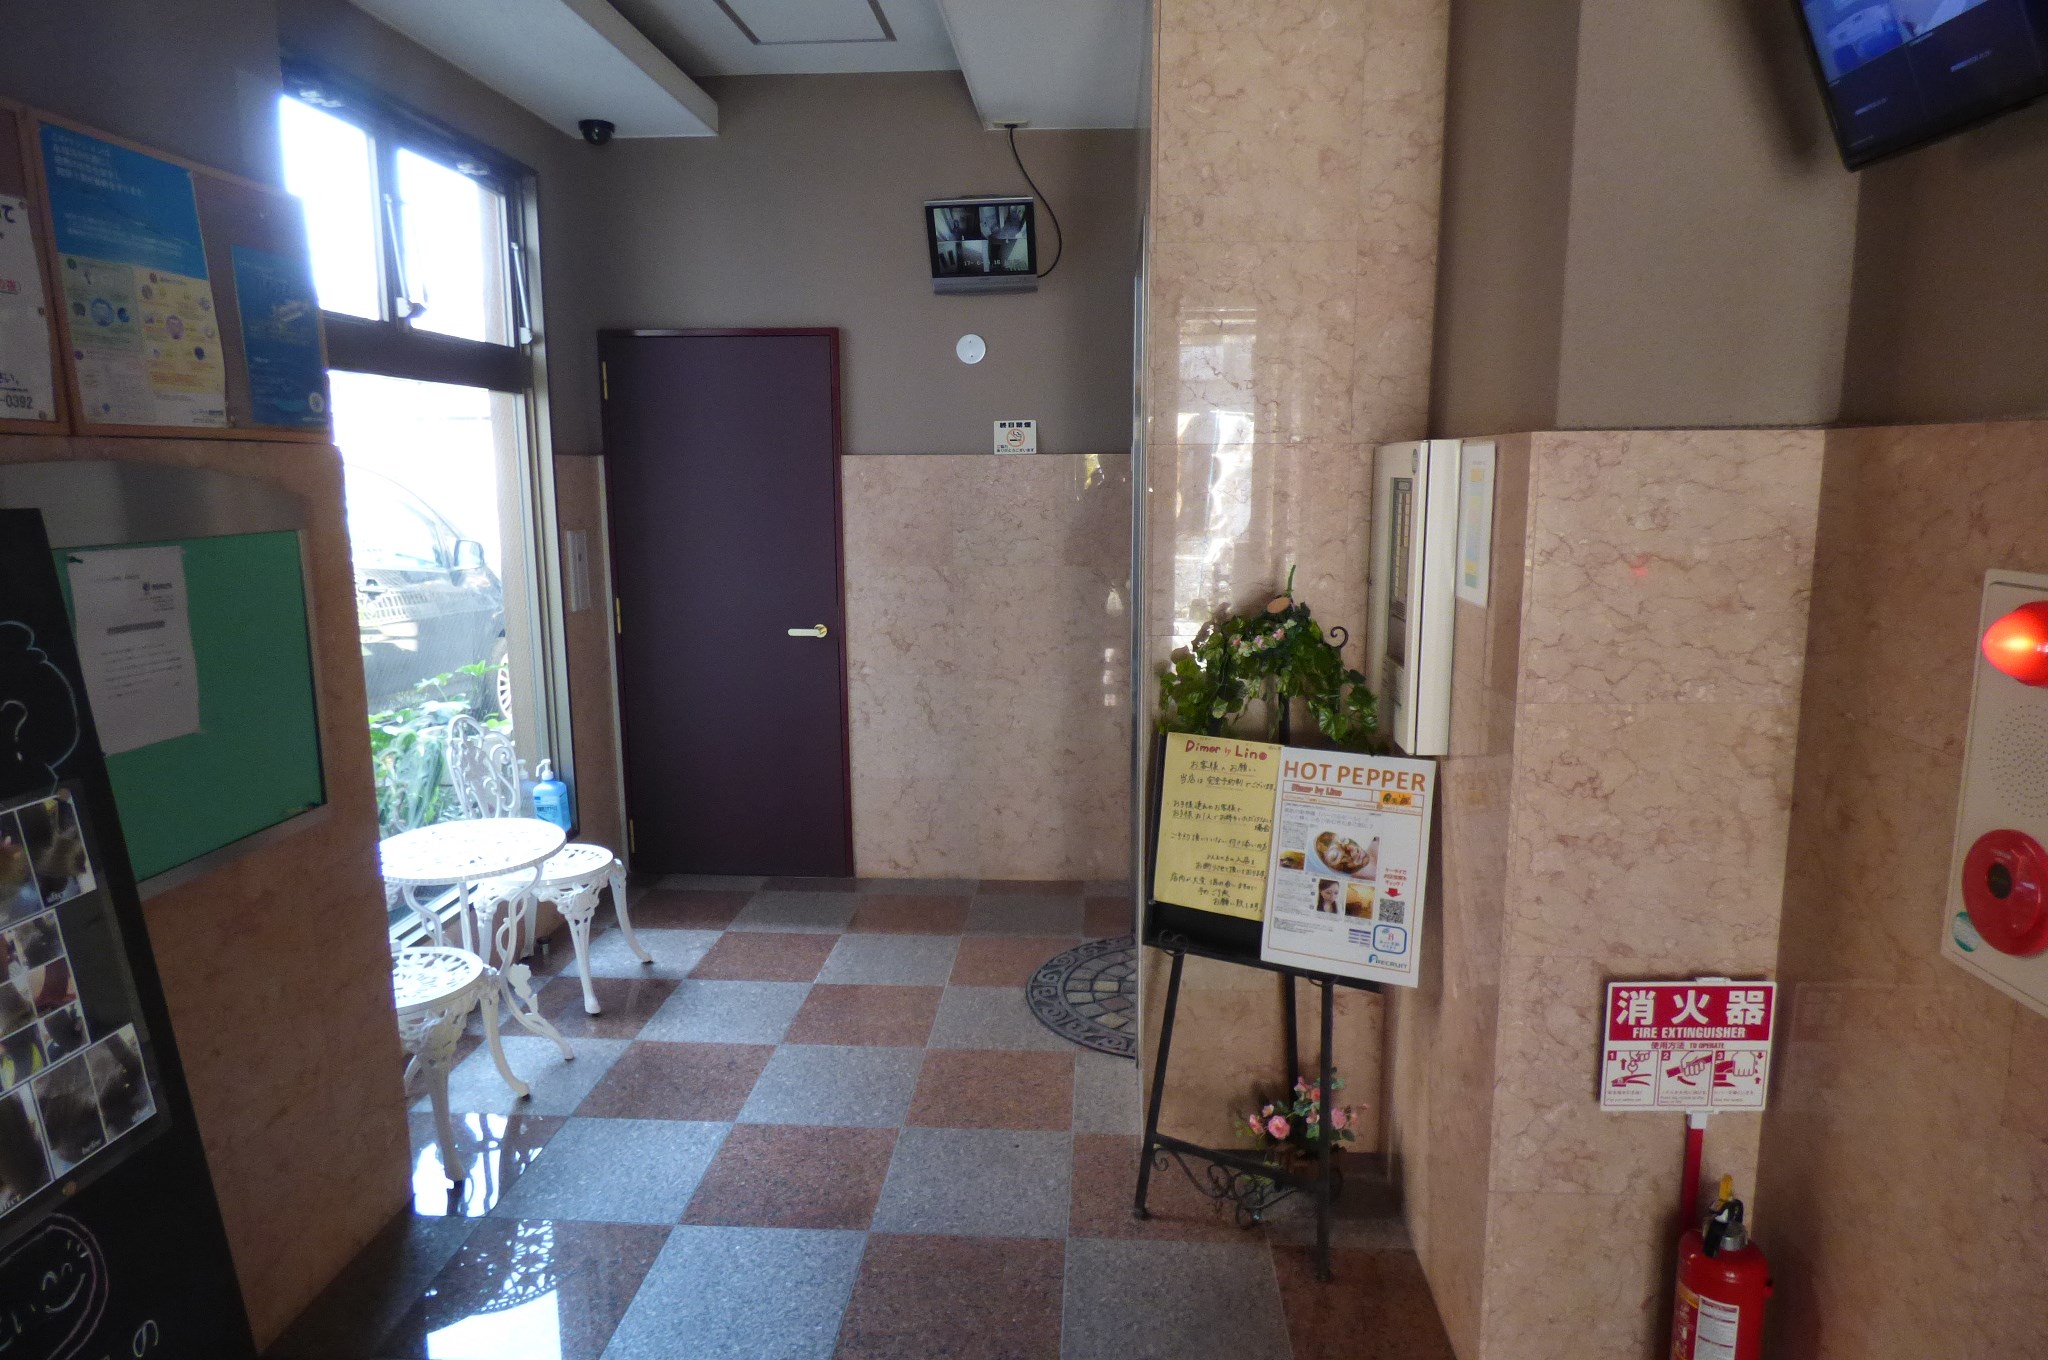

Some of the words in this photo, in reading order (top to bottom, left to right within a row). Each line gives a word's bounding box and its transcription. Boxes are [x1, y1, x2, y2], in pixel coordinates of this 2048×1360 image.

[1283, 760, 1332, 782] HOT
[1337, 765, 1426, 792] PEPPER
[1616, 989, 1766, 1026] 消火器
[1632, 1027, 1657, 1039] FIRE
[1661, 1027, 1746, 1039] EXTINGUISHER
[1651, 1041, 1685, 1050] 使用方法
